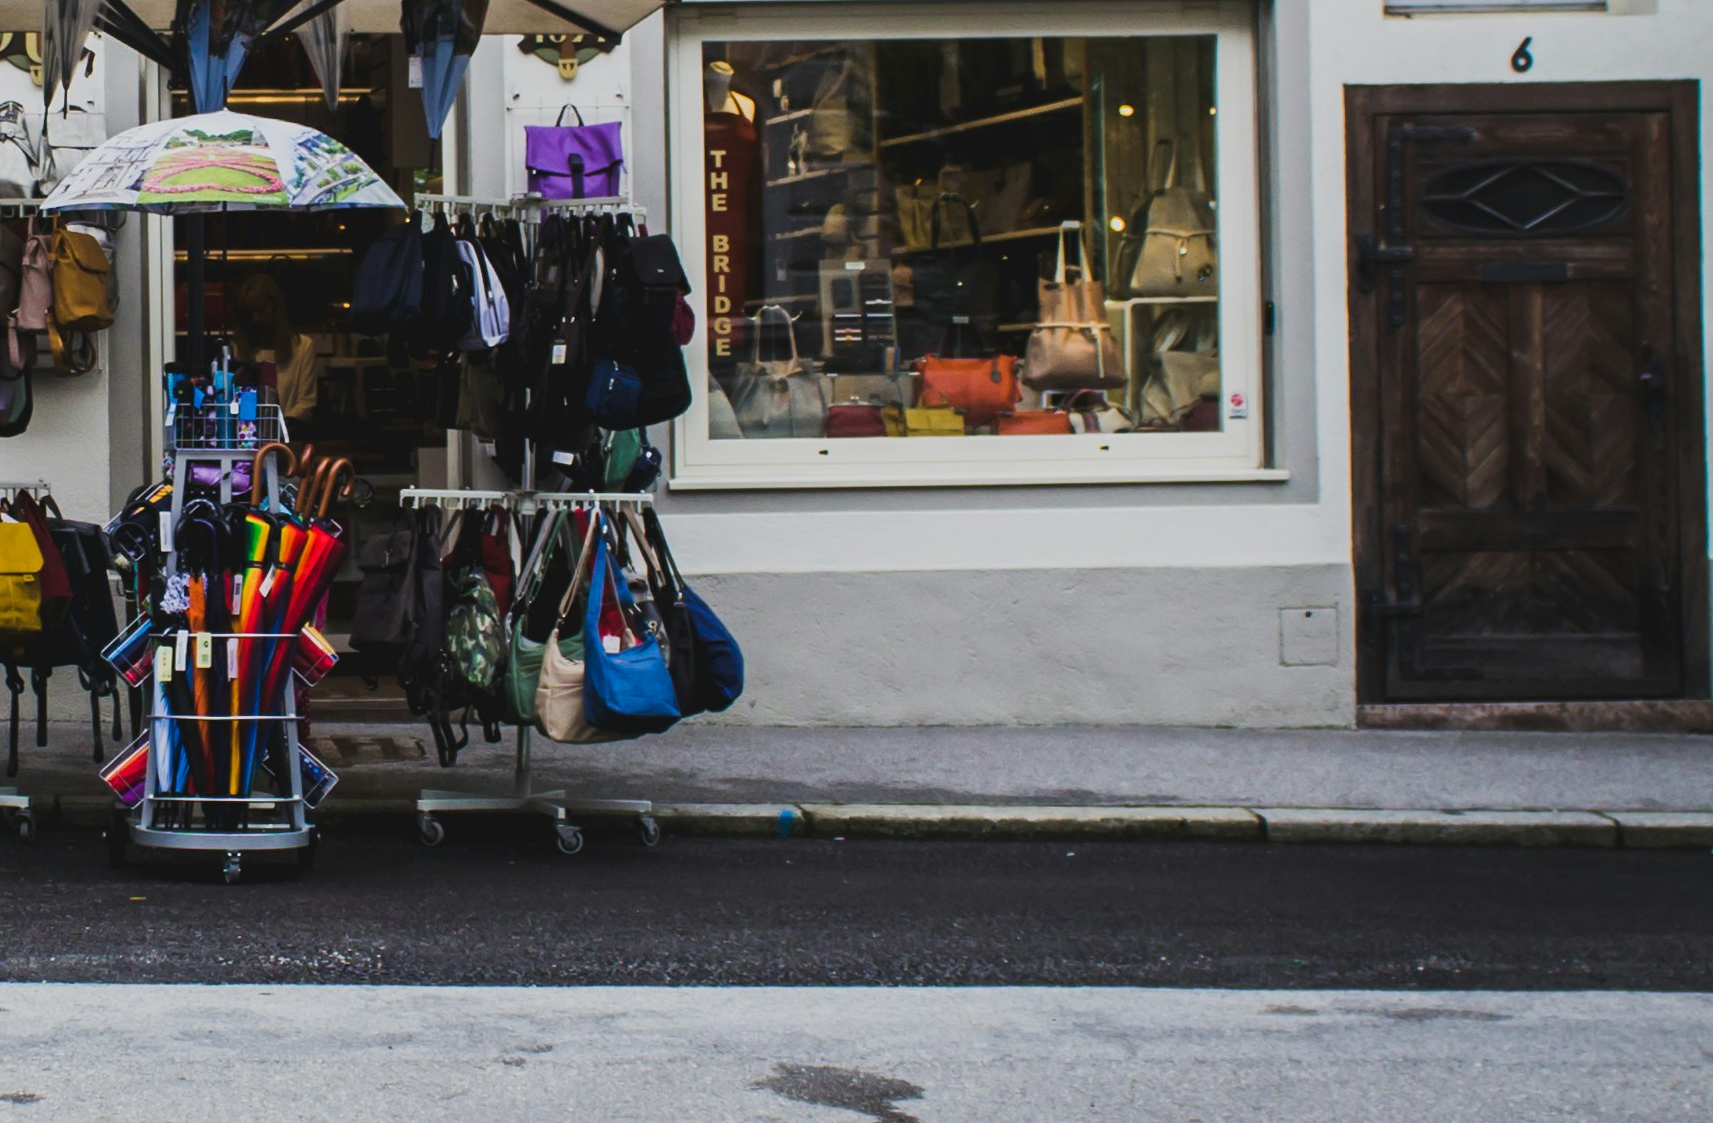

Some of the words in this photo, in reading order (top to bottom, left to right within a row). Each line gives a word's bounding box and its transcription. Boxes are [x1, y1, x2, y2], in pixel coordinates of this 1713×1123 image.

[1509, 35, 1534, 74] 6
[709, 149, 729, 212] THE
[712, 234, 732, 357] BRIDGE
